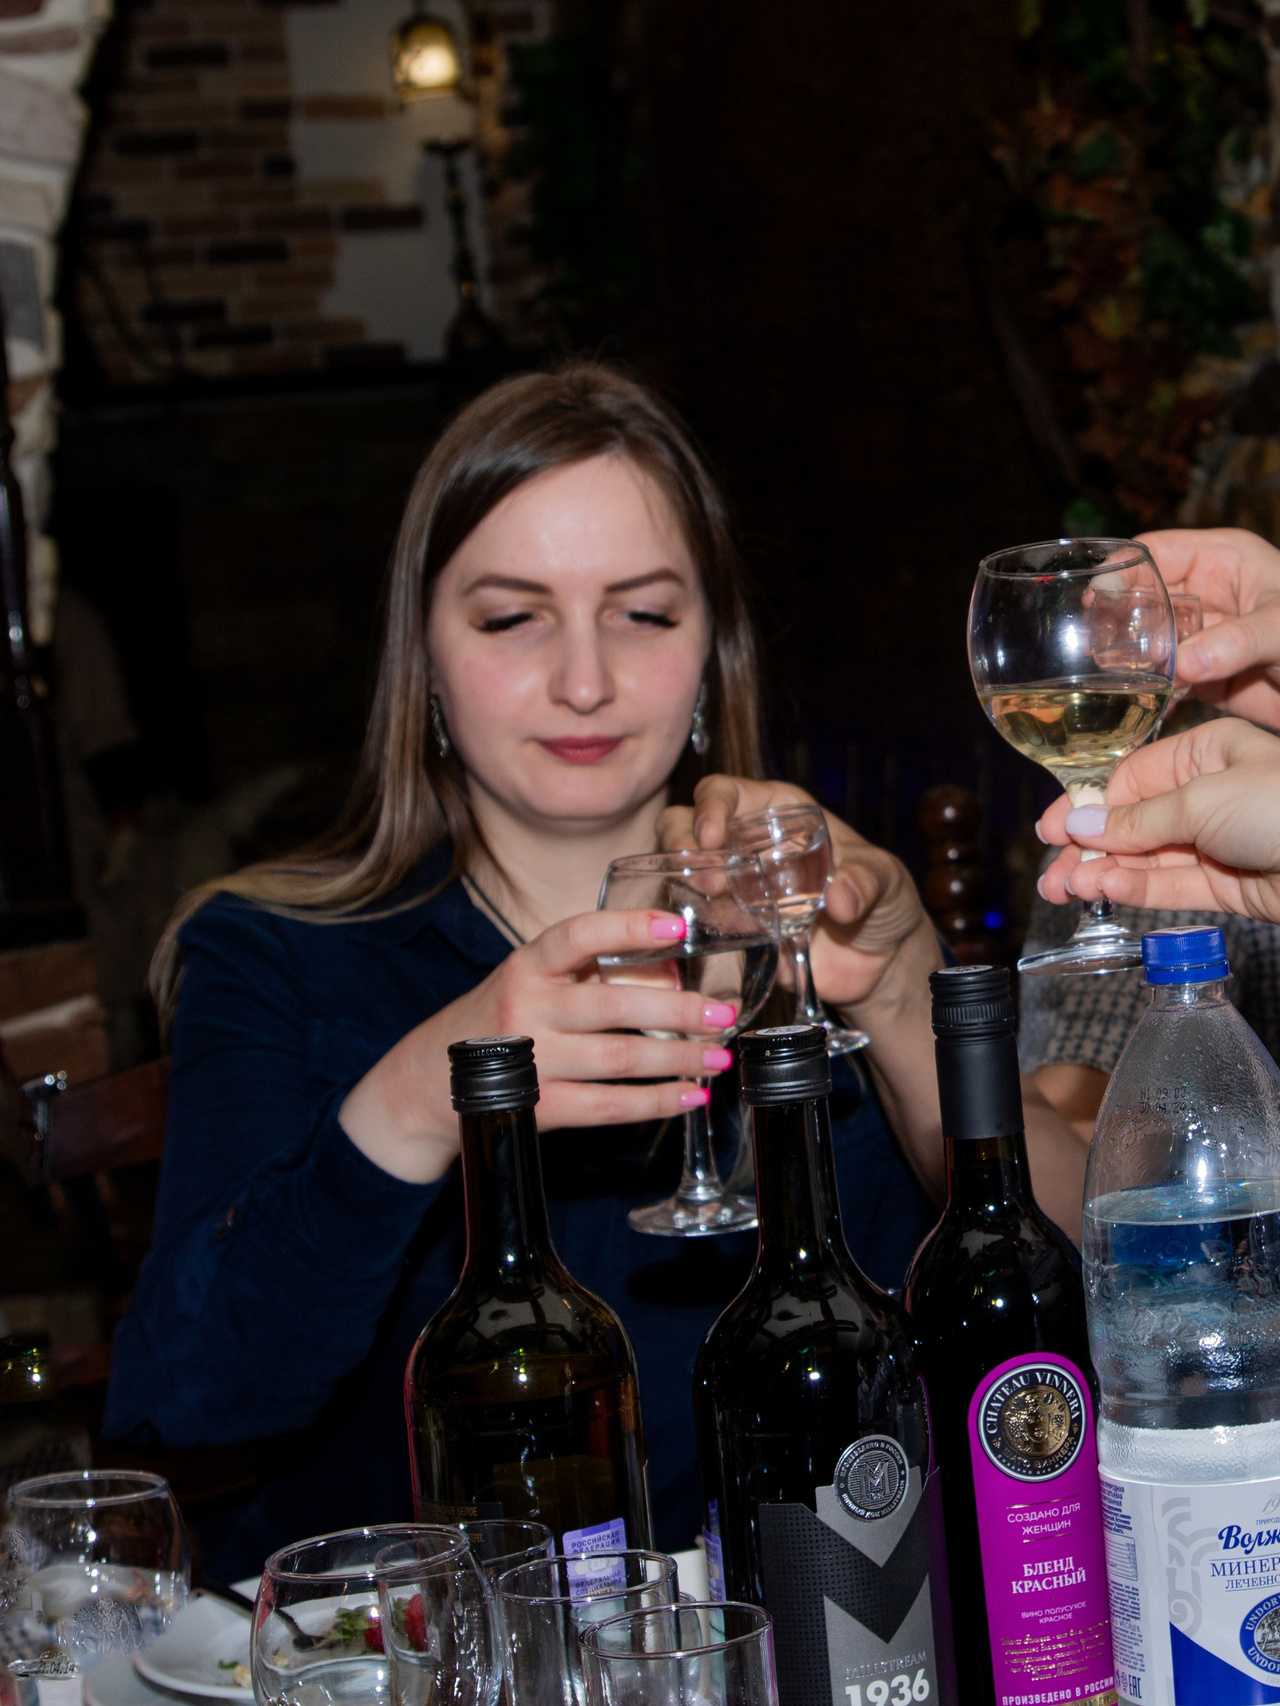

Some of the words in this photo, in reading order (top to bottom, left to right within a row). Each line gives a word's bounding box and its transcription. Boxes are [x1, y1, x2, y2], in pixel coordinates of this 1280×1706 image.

[986, 1373, 1030, 1434] CHATEAU
[1035, 1372, 1080, 1419] VINNERA
[1034, 1436, 1075, 1468] ВИННЕРА
[1007, 1508, 1060, 1523] СОЗДАНО
[1062, 1503, 1081, 1516] ДЛЯ
[1022, 1519, 1071, 1535] ЖЕНЩИН
[571, 1530, 620, 1549] РОССИЙСКАЯ
[572, 1536, 620, 1554] ФЕДЕРАЦИЯ
[1023, 1557, 1074, 1577] БЛЕНД
[1011, 1567, 1087, 1594] КРАСНЫЙ
[1021, 1609, 1043, 1619] ВИНО
[1045, 1601, 1086, 1616] ПОЛУСУХОЕ
[1039, 1612, 1073, 1624] КРАСНОЕ
[37, 1660, 77, 1675] 21.04.14
[845, 1668, 930, 1706] 1936
[1002, 1688, 1072, 1706] ПРОИЗВЕДЕНО
[1075, 1687, 1081, 1697] В
[1085, 1676, 1114, 1692] РОССИИ
